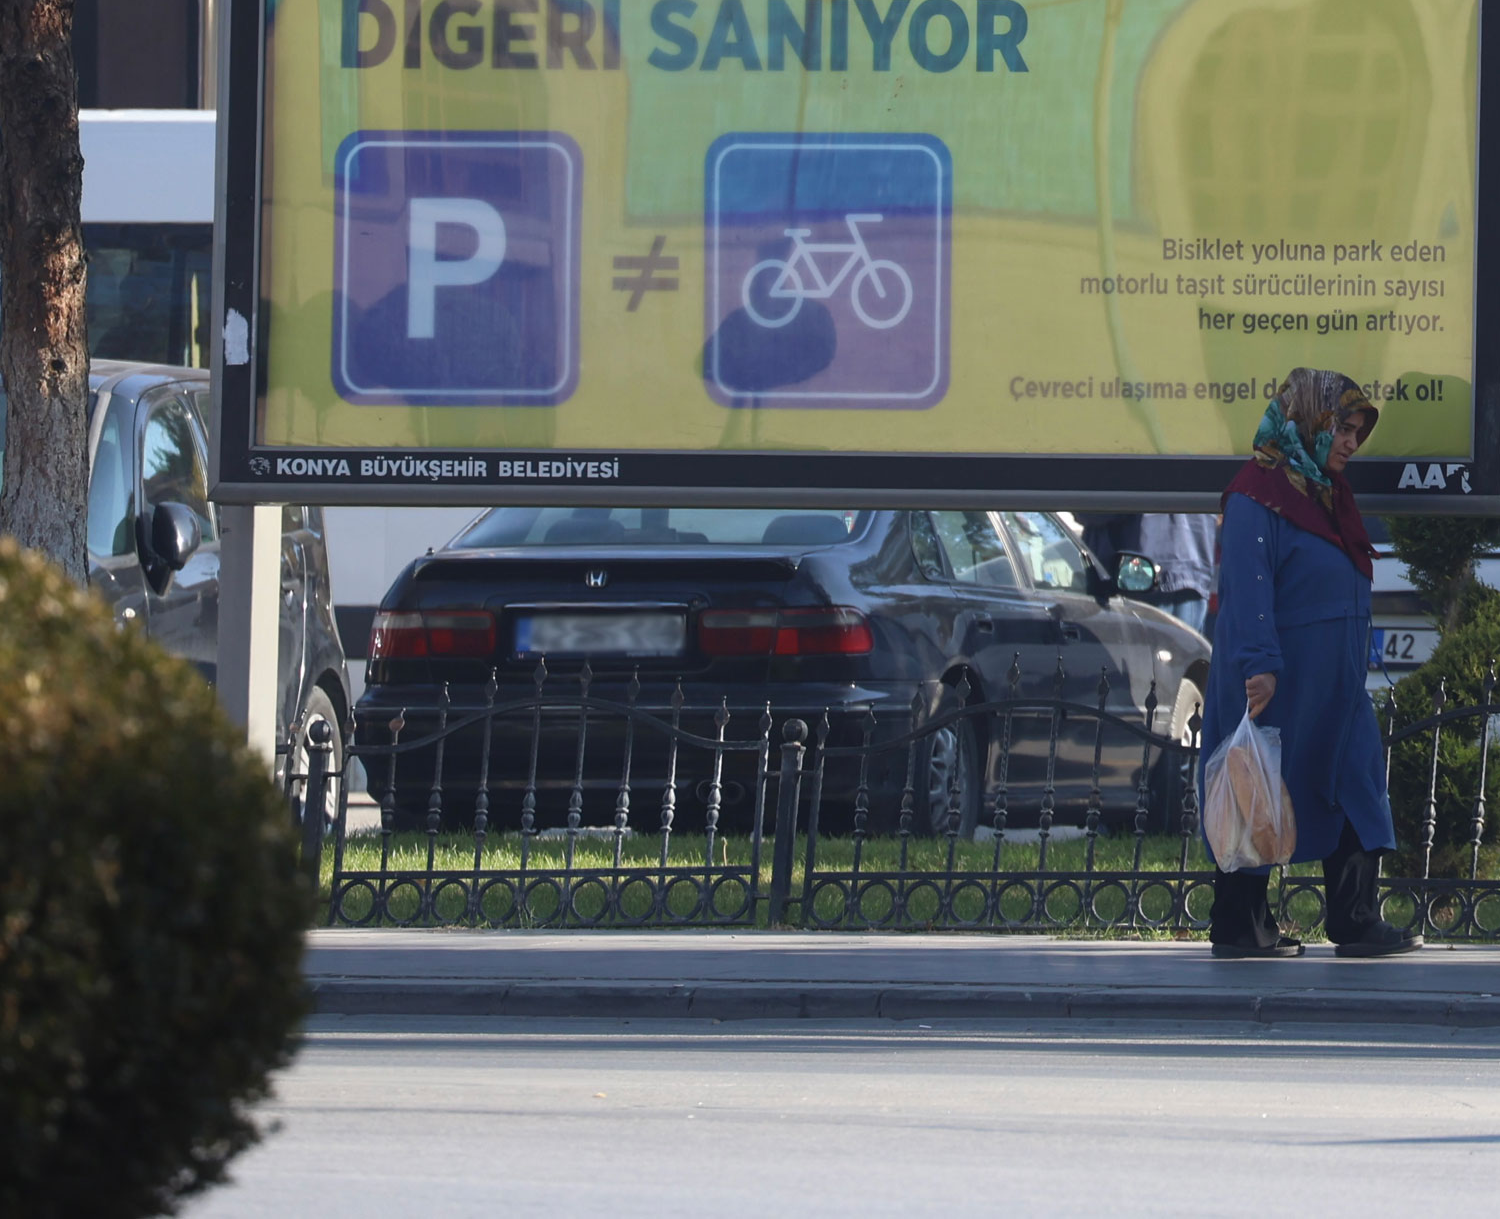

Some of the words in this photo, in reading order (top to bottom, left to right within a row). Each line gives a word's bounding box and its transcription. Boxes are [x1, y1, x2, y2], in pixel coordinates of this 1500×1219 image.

[1162, 238, 1245, 262] Bisiklet
[1251, 239, 1326, 265] yoluna
[1332, 239, 1383, 265] park
[1390, 240, 1446, 263] eden
[406, 196, 507, 340] P
[1080, 273, 1169, 296] motorlu
[1176, 276, 1225, 299] taşıt
[1232, 274, 1376, 297] sürücülerinin
[1383, 279, 1445, 301] sayısı
[1199, 308, 1235, 330] her
[1242, 313, 1309, 334] geçen
[1316, 310, 1358, 334] gün
[1366, 312, 1444, 335] artıyor.
[1009, 376, 1093, 402] Çevreci
[1100, 377, 1187, 402] ulaşıma
[1194, 378, 1256, 403] engel
[1362, 379, 1409, 402] stek
[1415, 379, 1443, 402] ol!
[276, 457, 351, 476] KONYA
[360, 456, 488, 481] BÜYÜKŞEHİR
[498, 457, 620, 478] BELEDİYESİ
[1385, 633, 1416, 660] 42
